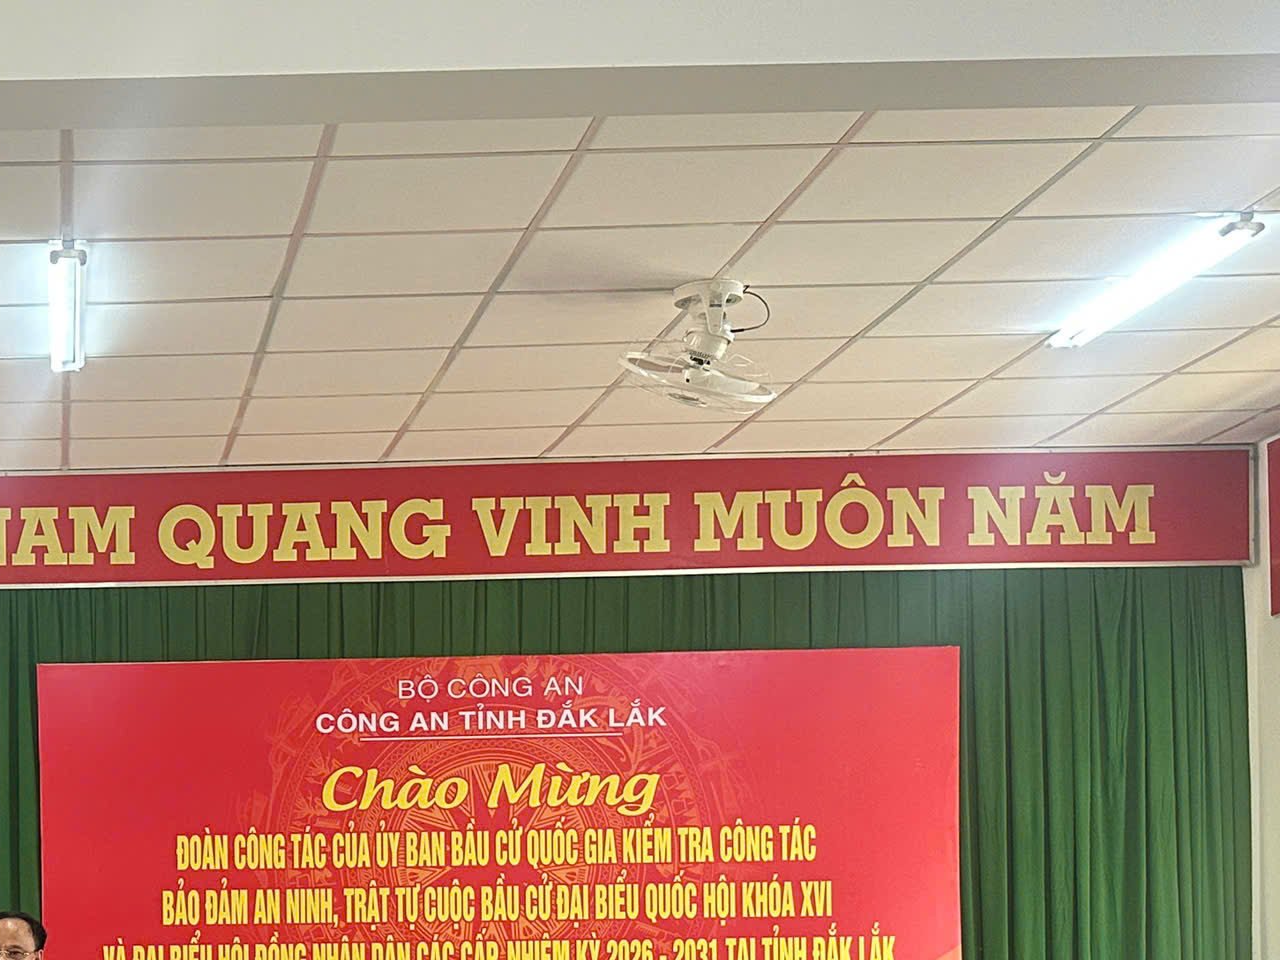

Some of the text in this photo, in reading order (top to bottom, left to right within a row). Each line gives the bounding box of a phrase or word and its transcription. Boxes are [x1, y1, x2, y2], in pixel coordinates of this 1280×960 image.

[157, 498, 451, 570] QUANG
[471, 492, 671, 558] VINH
[694, 472, 945, 552] MUÔN
[967, 470, 1158, 548] NĂM
[315, 698, 667, 734] CÔNG AN TỈNH ĐẮK LẮK
[397, 673, 584, 703] BỘ CÔNG AN
[322, 762, 661, 817] Chào Mừng
[176, 812, 817, 871] ĐOÀN CÔNG TÁC CỦA ỦY BAN BẦU CỬ QUỐC GIA KIỂM TRA CÔNG TÁC
[162, 868, 833, 931] BẢO ĐẢM AN NINH, TRẬT TỰ CUỘC BẦU CỬ ĐẠI BIỂU QUỐC HỘI KHÓA XVI
